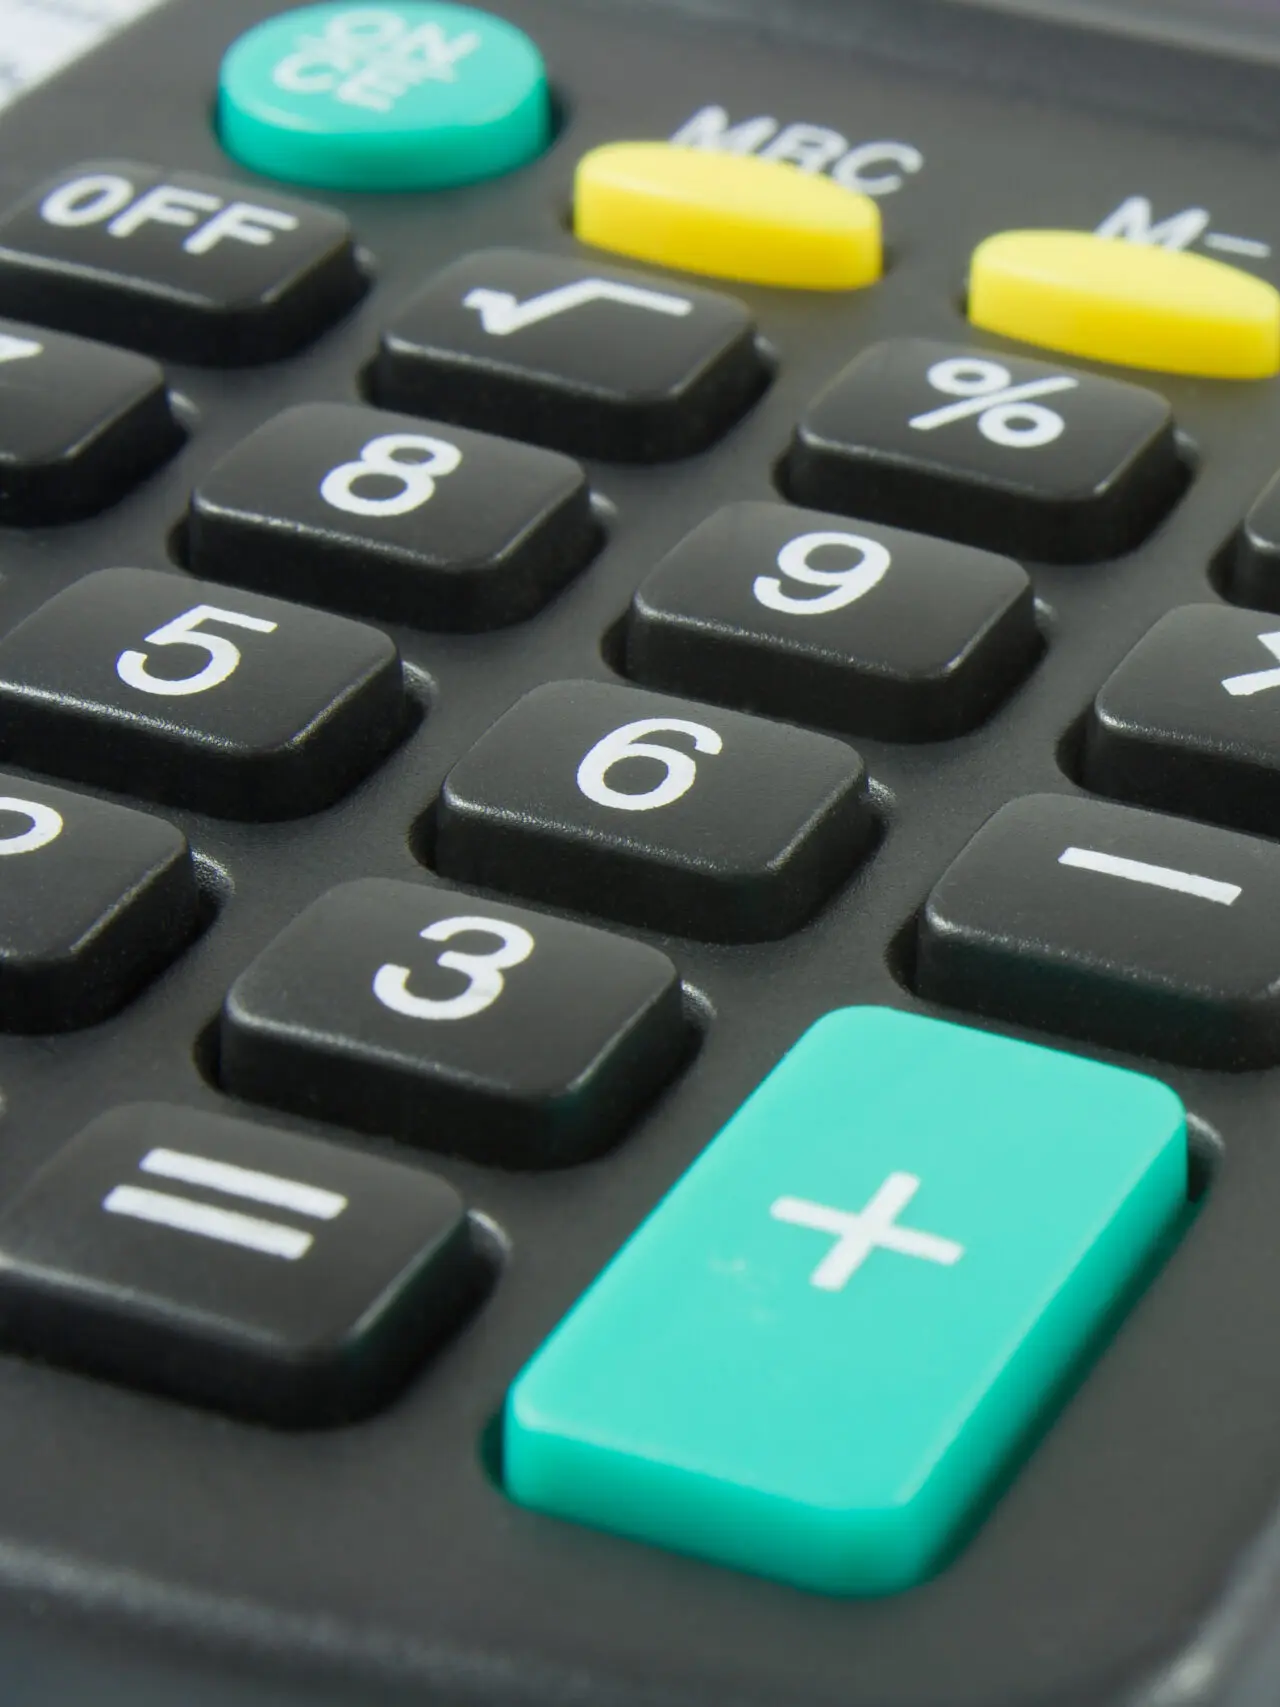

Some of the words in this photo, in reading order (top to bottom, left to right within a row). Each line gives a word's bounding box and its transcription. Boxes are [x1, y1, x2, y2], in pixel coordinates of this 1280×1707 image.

[41, 174, 299, 254] OFF
[909, 357, 1080, 448] %
[320, 433, 463, 517] 8
[753, 531, 892, 615] 9
[116, 604, 278, 696] 5
[576, 717, 724, 811] 6
[373, 915, 535, 1020] 3
